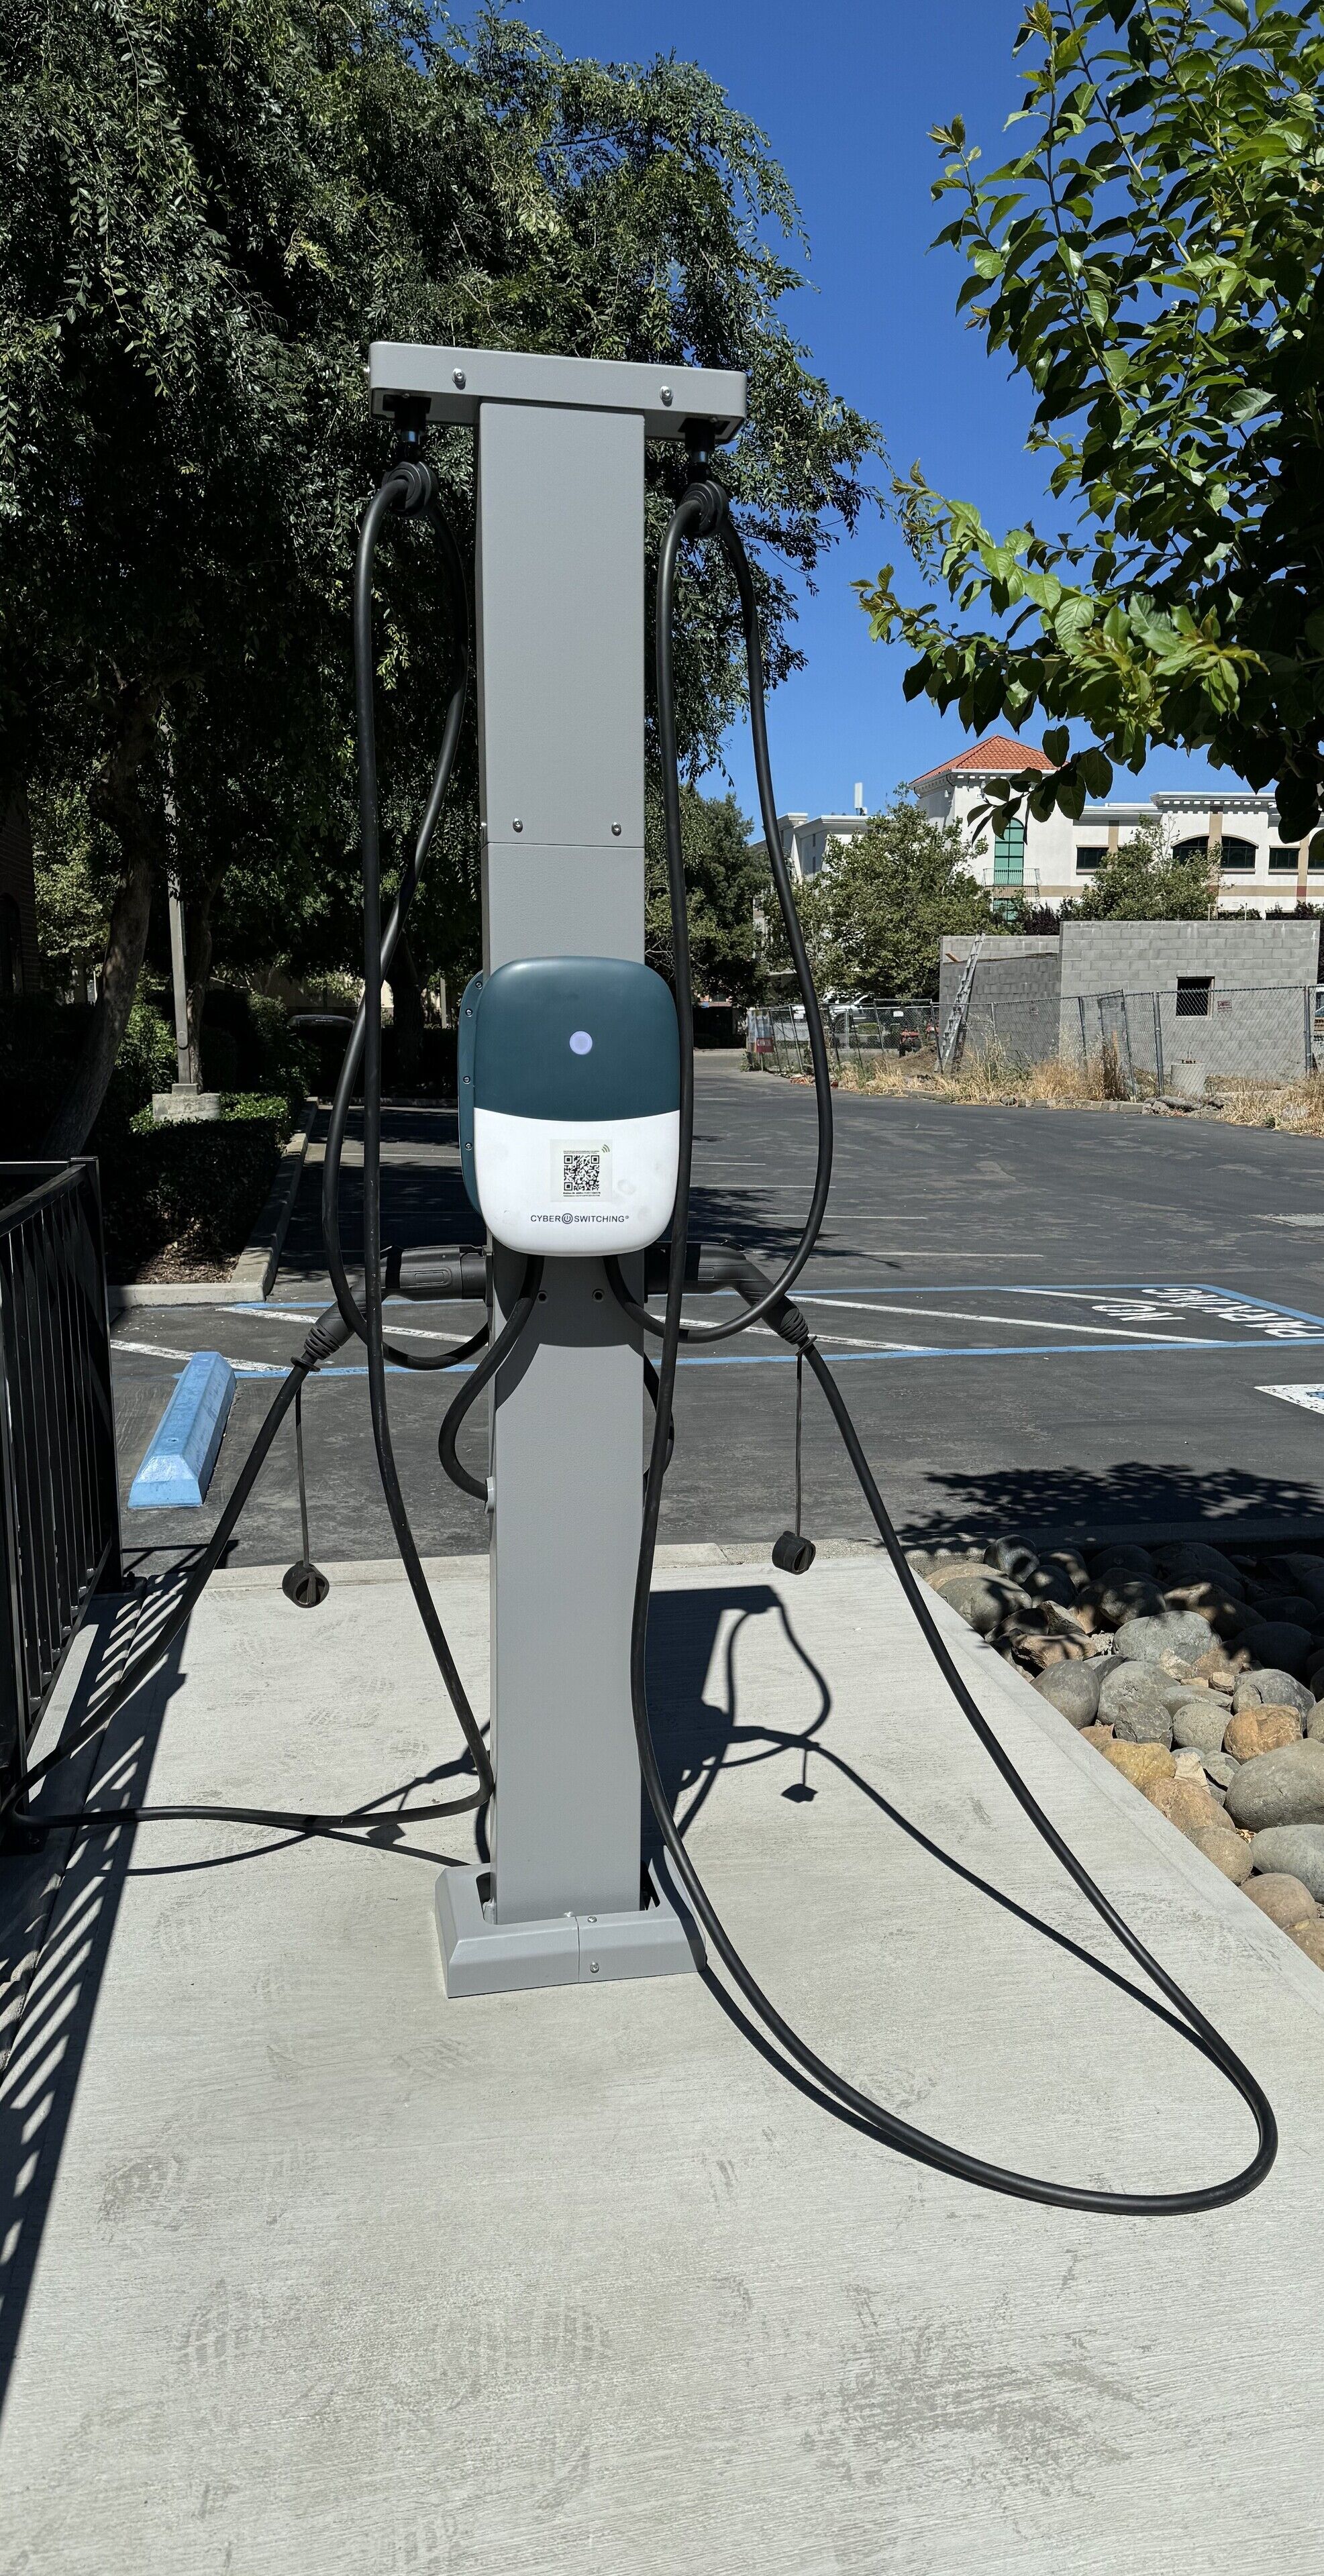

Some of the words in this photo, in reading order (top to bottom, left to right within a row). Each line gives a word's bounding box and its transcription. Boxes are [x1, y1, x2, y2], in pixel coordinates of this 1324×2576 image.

[530, 1215, 561, 1223] CYBER
[1092, 1304, 1186, 1322] NO
[1141, 1288, 1324, 1338] PARKING
